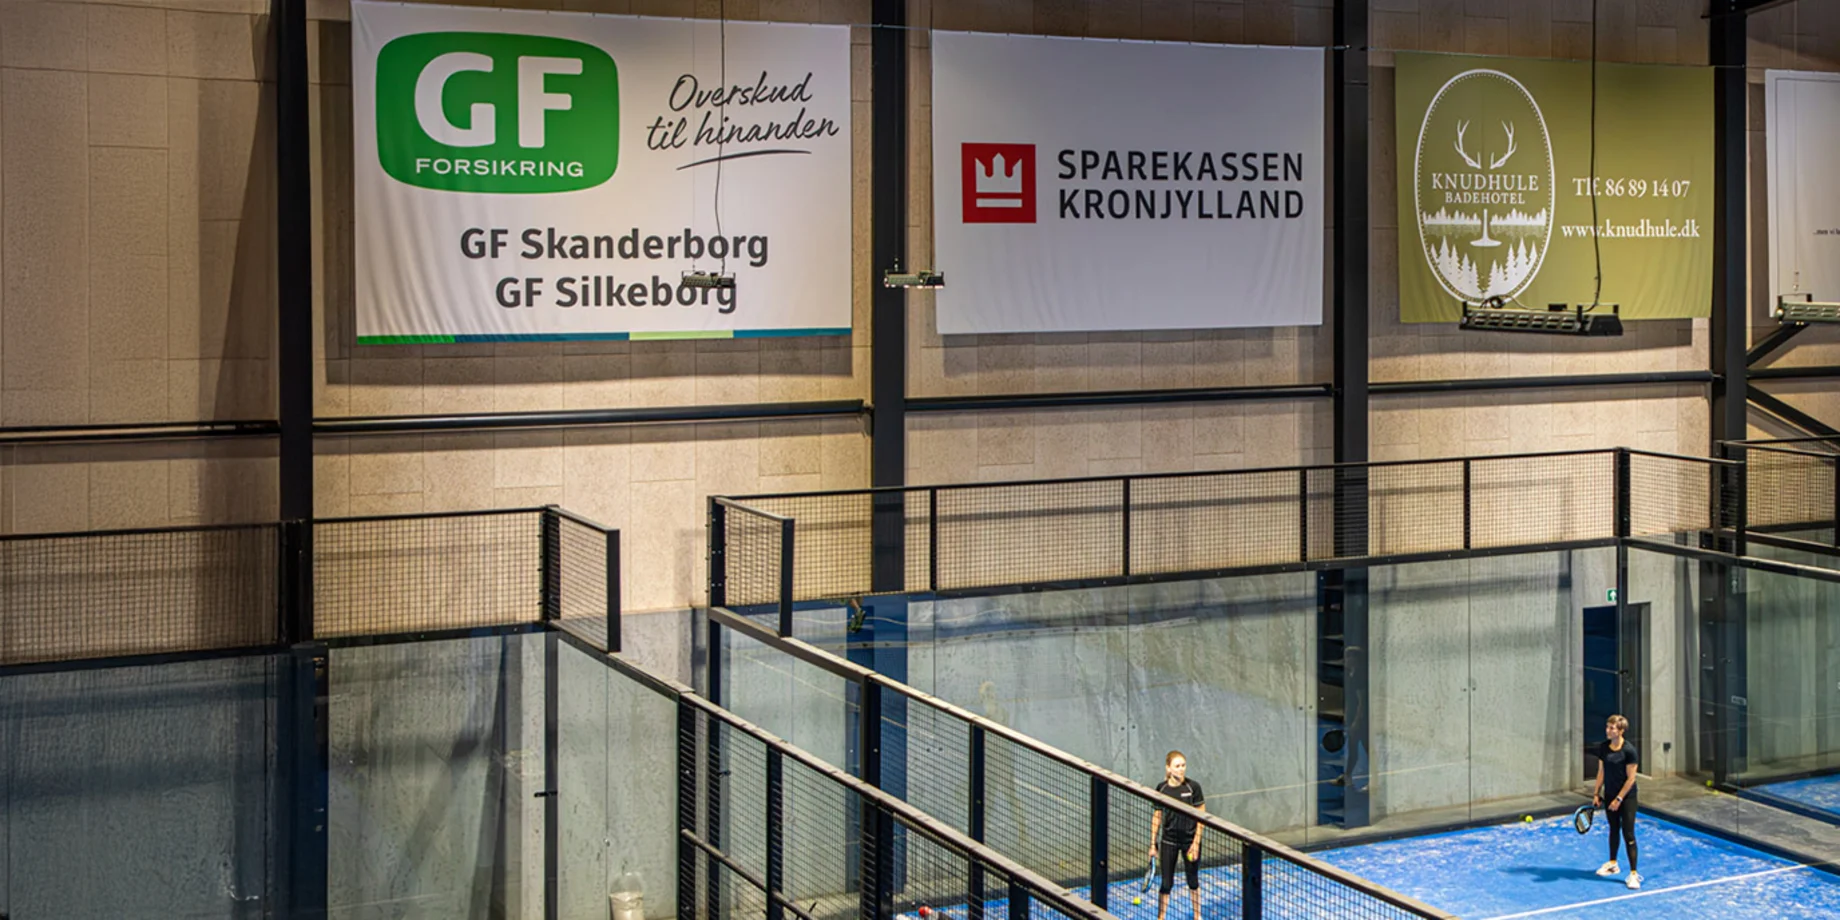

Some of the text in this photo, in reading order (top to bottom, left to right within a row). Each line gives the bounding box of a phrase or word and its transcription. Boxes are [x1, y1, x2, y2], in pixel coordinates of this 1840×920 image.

[414, 51, 583, 148] GF
[669, 70, 813, 112] Overskud
[646, 106, 840, 150] til hinanden
[415, 157, 584, 177] FORSIKRING
[1057, 149, 1303, 181] SPAREKASSEN
[1432, 172, 1539, 191] KNUDHULE
[1572, 177, 1690, 198] Tlf. 86 89 14 07
[1059, 189, 1304, 219] KRONJYLLAND
[1445, 191, 1526, 204] BADEHOTEL
[1561, 219, 1700, 238] www.knudhule.dk
[460, 227, 769, 267] GF Skanderborg
[495, 275, 737, 314] GF Silkeborg
